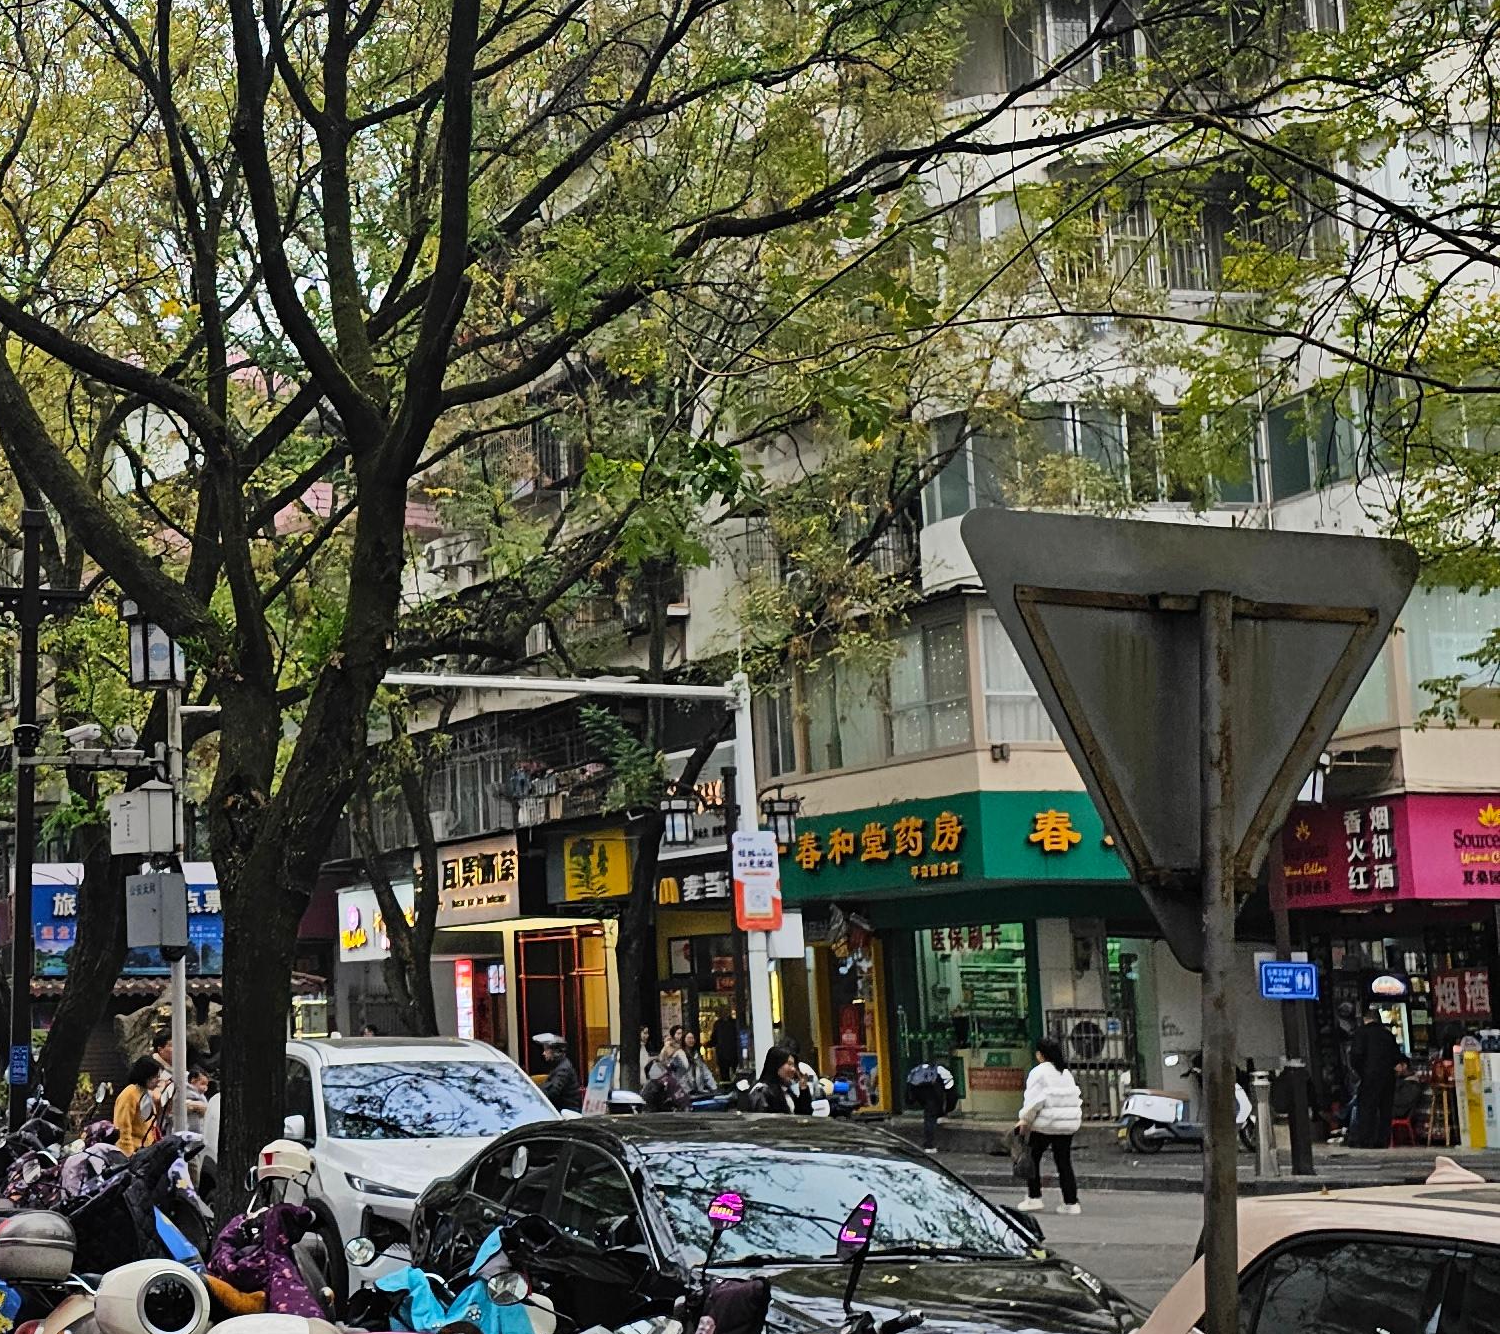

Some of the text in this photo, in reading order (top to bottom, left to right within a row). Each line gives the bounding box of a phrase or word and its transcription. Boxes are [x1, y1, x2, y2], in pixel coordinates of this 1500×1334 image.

[1343, 806, 1390, 834] 香烟
[795, 811, 962, 870] 春和堂药房
[1346, 834, 1392, 862] 火机
[683, 870, 730, 902] 麦当
[1348, 863, 1395, 890] 红酒
[1434, 970, 1491, 1014] 烟酒
